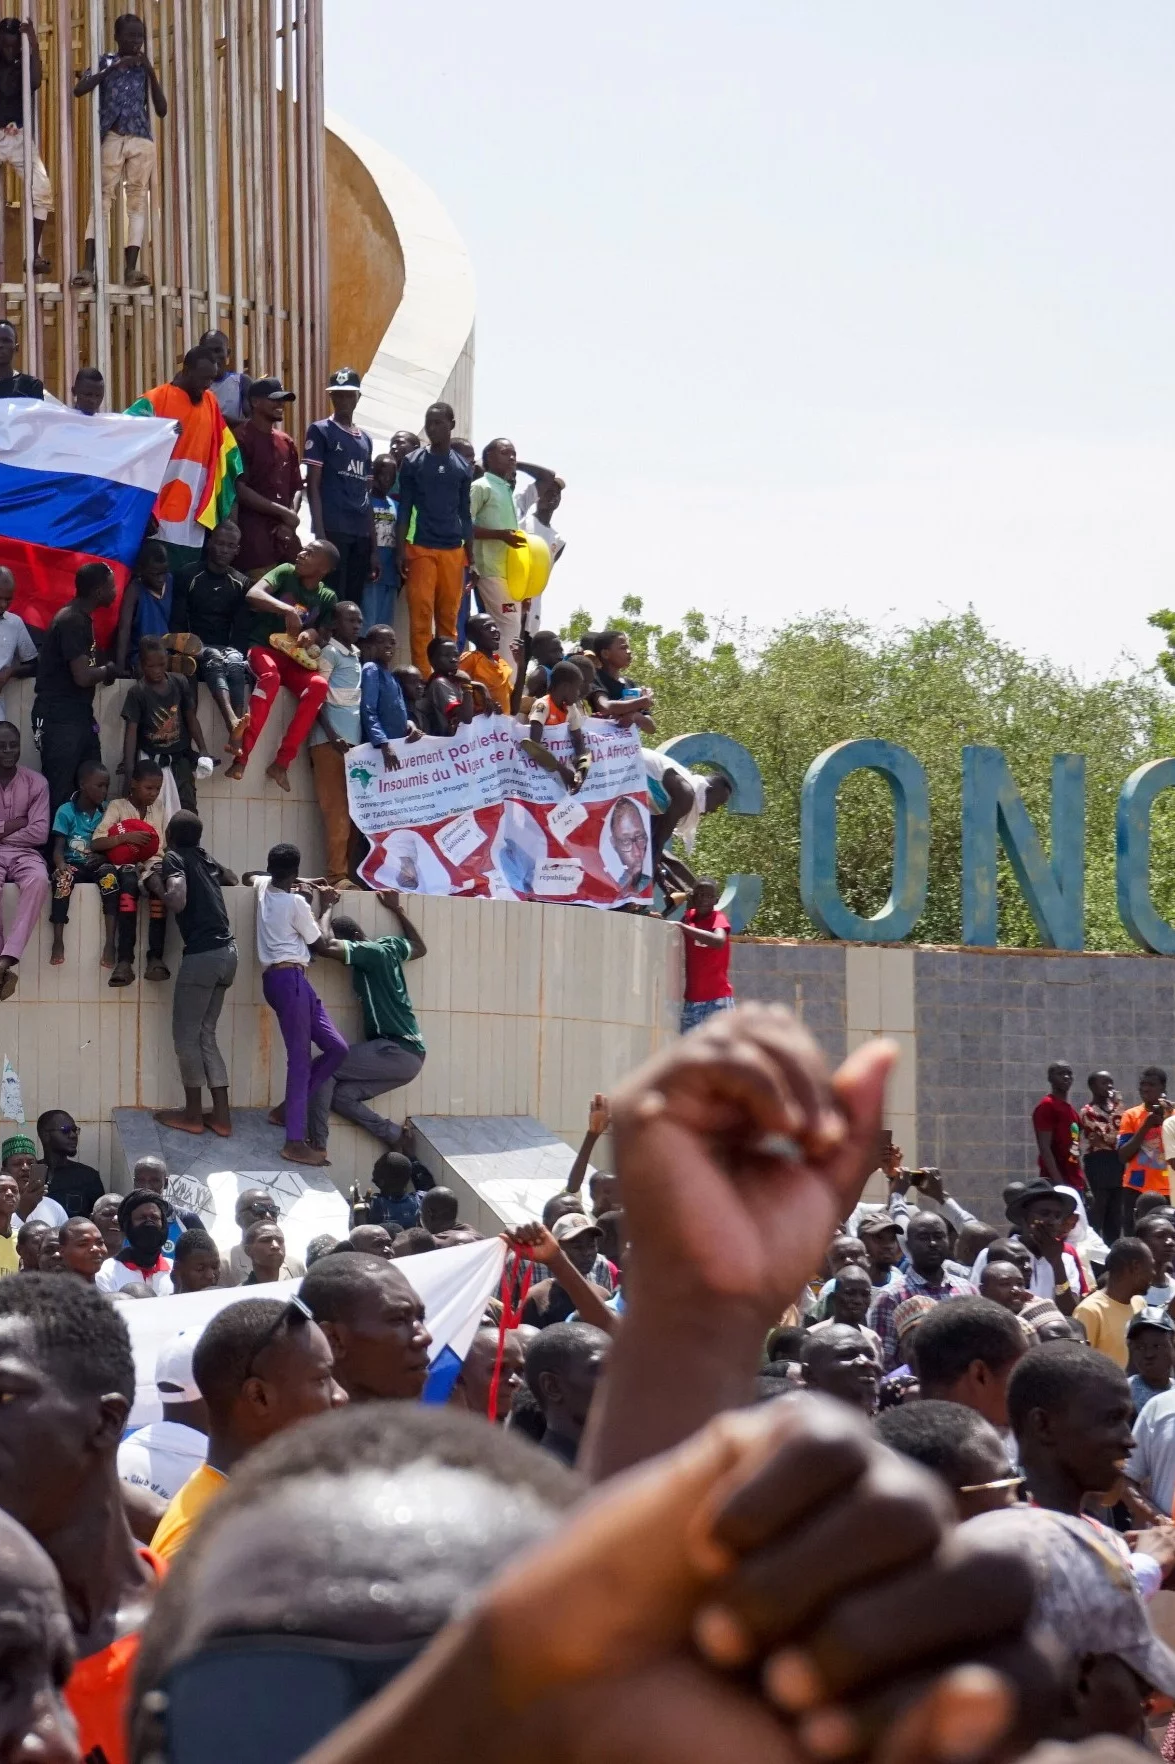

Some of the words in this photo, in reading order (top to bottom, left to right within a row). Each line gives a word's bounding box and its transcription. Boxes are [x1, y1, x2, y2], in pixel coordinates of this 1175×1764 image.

[384, 749, 445, 773] uvement
[379, 772, 428, 793] Insoumis
[432, 767, 451, 783] du
[454, 756, 484, 777] Niger
[539, 873, 574, 883] république
[130, 1474, 149, 1487] Club
